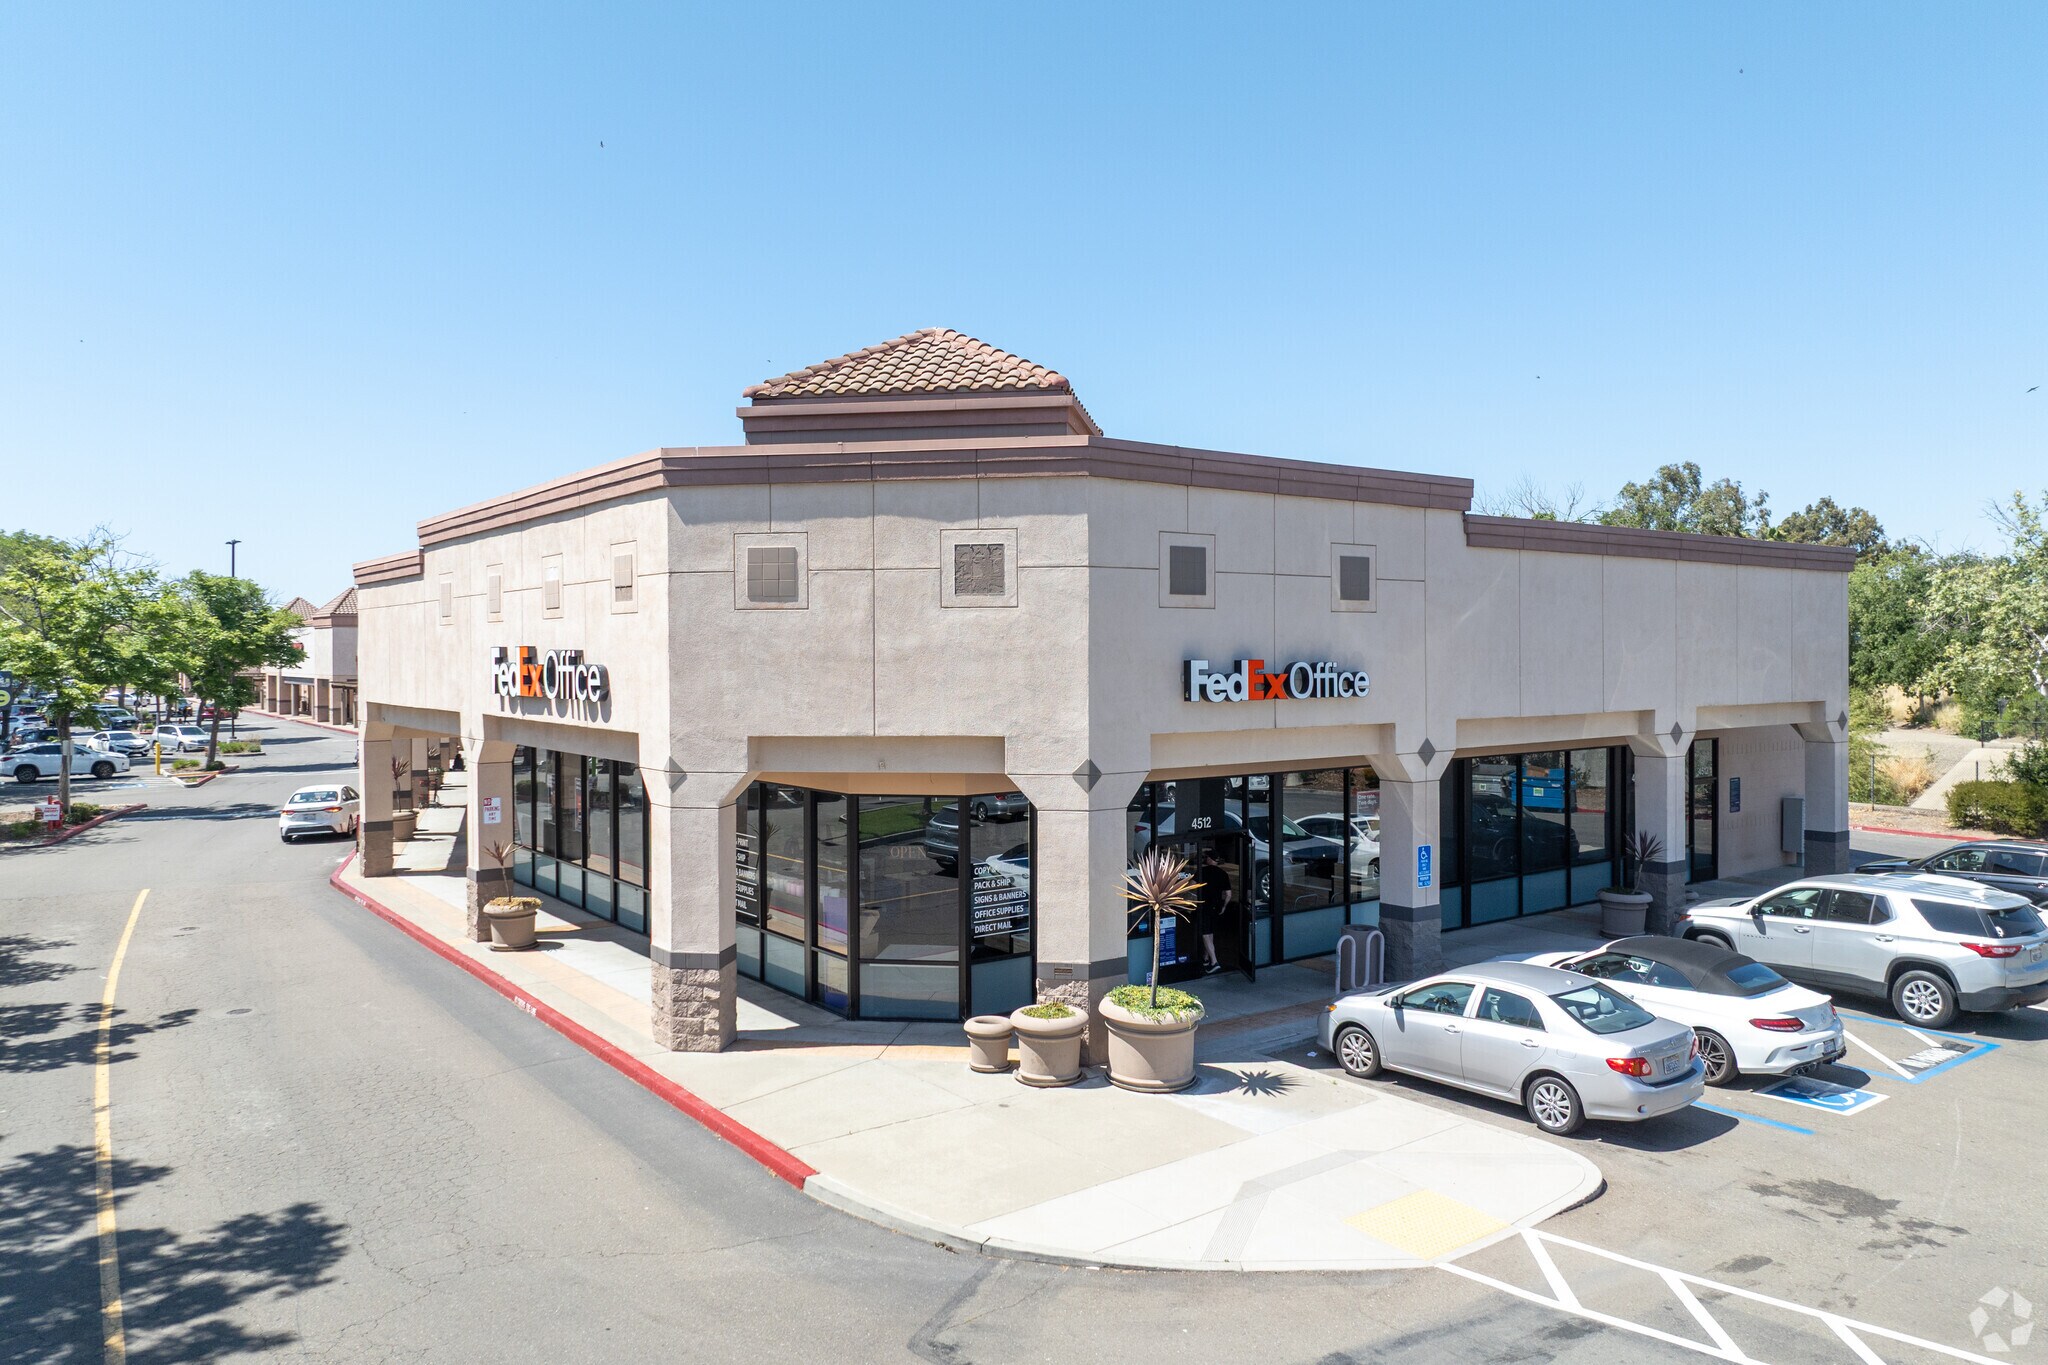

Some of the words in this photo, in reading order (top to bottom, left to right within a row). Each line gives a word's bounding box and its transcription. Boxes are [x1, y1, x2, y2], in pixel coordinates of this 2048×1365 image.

[490, 646, 543, 697] FedEx
[543, 649, 602, 702] Office
[1185, 659, 1289, 702] FedEx
[1288, 661, 1370, 699] Office
[1191, 816, 1212, 829] 4512
[974, 866, 990, 875] COPY
[737, 884, 754, 896] SUPPLIES
[974, 880, 991, 890] PACK
[991, 879, 996, 888] &
[996, 878, 1011, 887] SHIP
[974, 895, 993, 904] SIGNS
[993, 894, 998, 902] &
[999, 890, 1027, 901] BANNERS
[974, 908, 996, 919] OFFICE
[996, 905, 1024, 917] SUPPLIES
[974, 923, 997, 934] DIRECT
[997, 920, 1013, 930] MAIL
